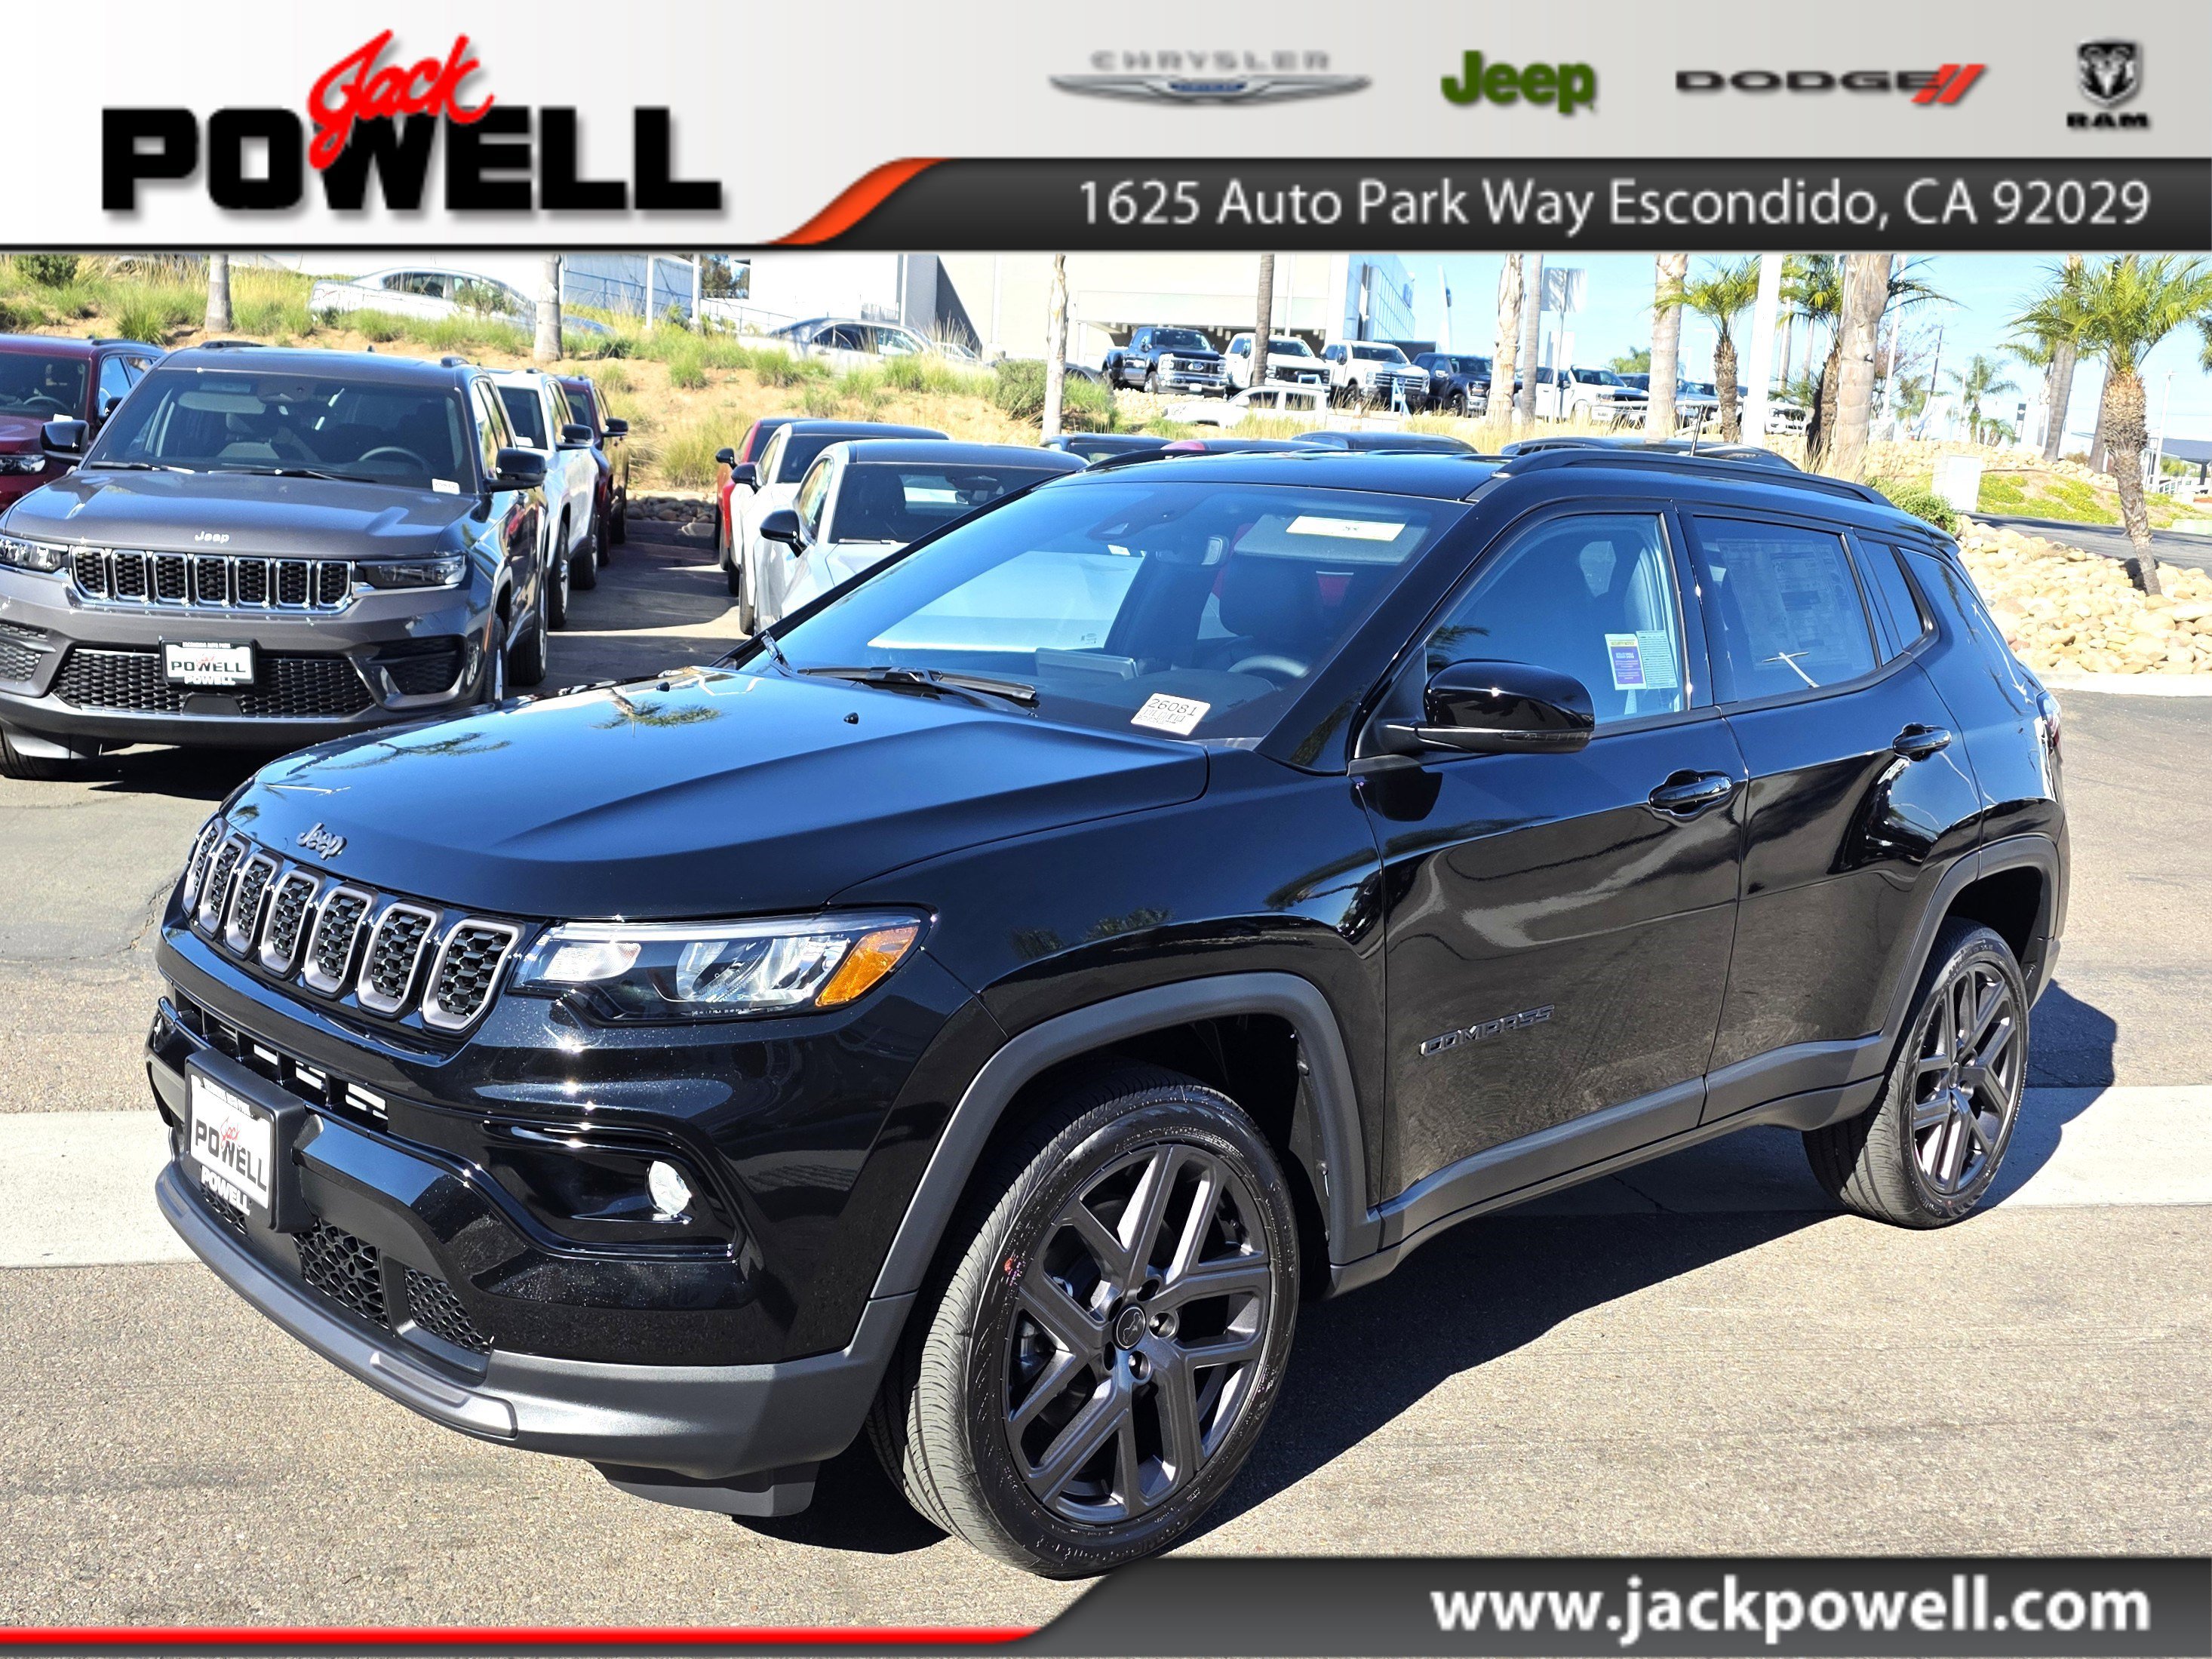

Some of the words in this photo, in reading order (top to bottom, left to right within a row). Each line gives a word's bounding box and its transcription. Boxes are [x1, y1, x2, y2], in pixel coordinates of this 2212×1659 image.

[171, 661, 246, 673] POWELL
[183, 676, 236, 686] POWELL
[1147, 698, 1198, 717] 26081
[295, 822, 347, 861] Jeep
[1419, 1003, 1555, 1057] COMPASS
[195, 1118, 267, 1193] POWELL
[201, 1165, 250, 1216] POWELL
